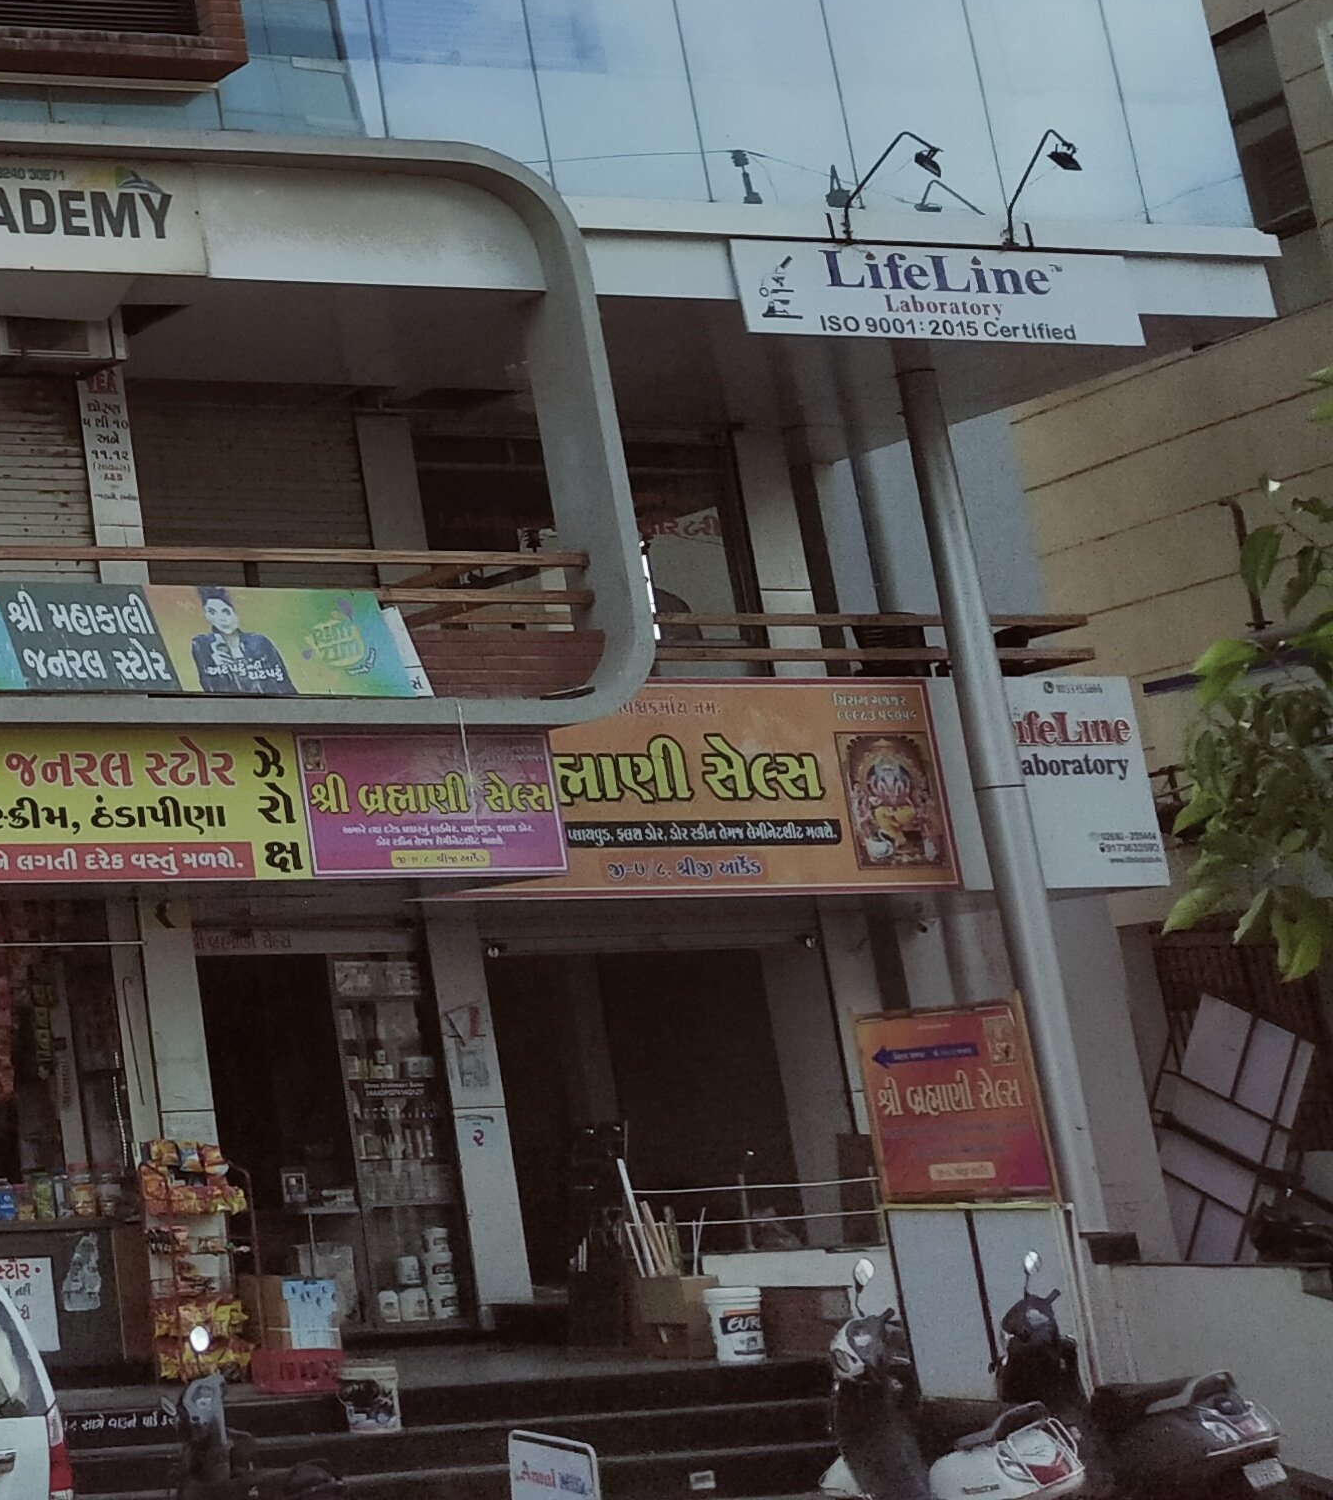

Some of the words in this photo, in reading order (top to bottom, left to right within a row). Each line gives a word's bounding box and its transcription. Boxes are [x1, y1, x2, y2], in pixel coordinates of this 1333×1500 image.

[818, 250, 1052, 295] LifeLine
[821, 317, 860, 332] ISO
[983, 321, 1077, 341] Certified
[885, 295, 1002, 320] Laboratory
[7, 590, 43, 632] શ્રી
[23, 648, 107, 679] જનરલ
[112, 638, 172, 681] સ્ટોર
[1013, 711, 1131, 745] ifeLine
[4, 752, 134, 789] જનરલ
[144, 735, 237, 789] સ્ટોર
[701, 733, 826, 802] સેલ્સ
[1022, 753, 1129, 780] aboratory
[310, 772, 351, 815] શ્રી
[482, 770, 554, 814] સેલ્સ
[90, 794, 227, 837] ઠંડાપીણા
[16, 848, 78, 872] લગતી
[84, 847, 124, 872] દરેક
[878, 1076, 904, 1116] શ્રી
[978, 1067, 1024, 1109] સેલ્સ
